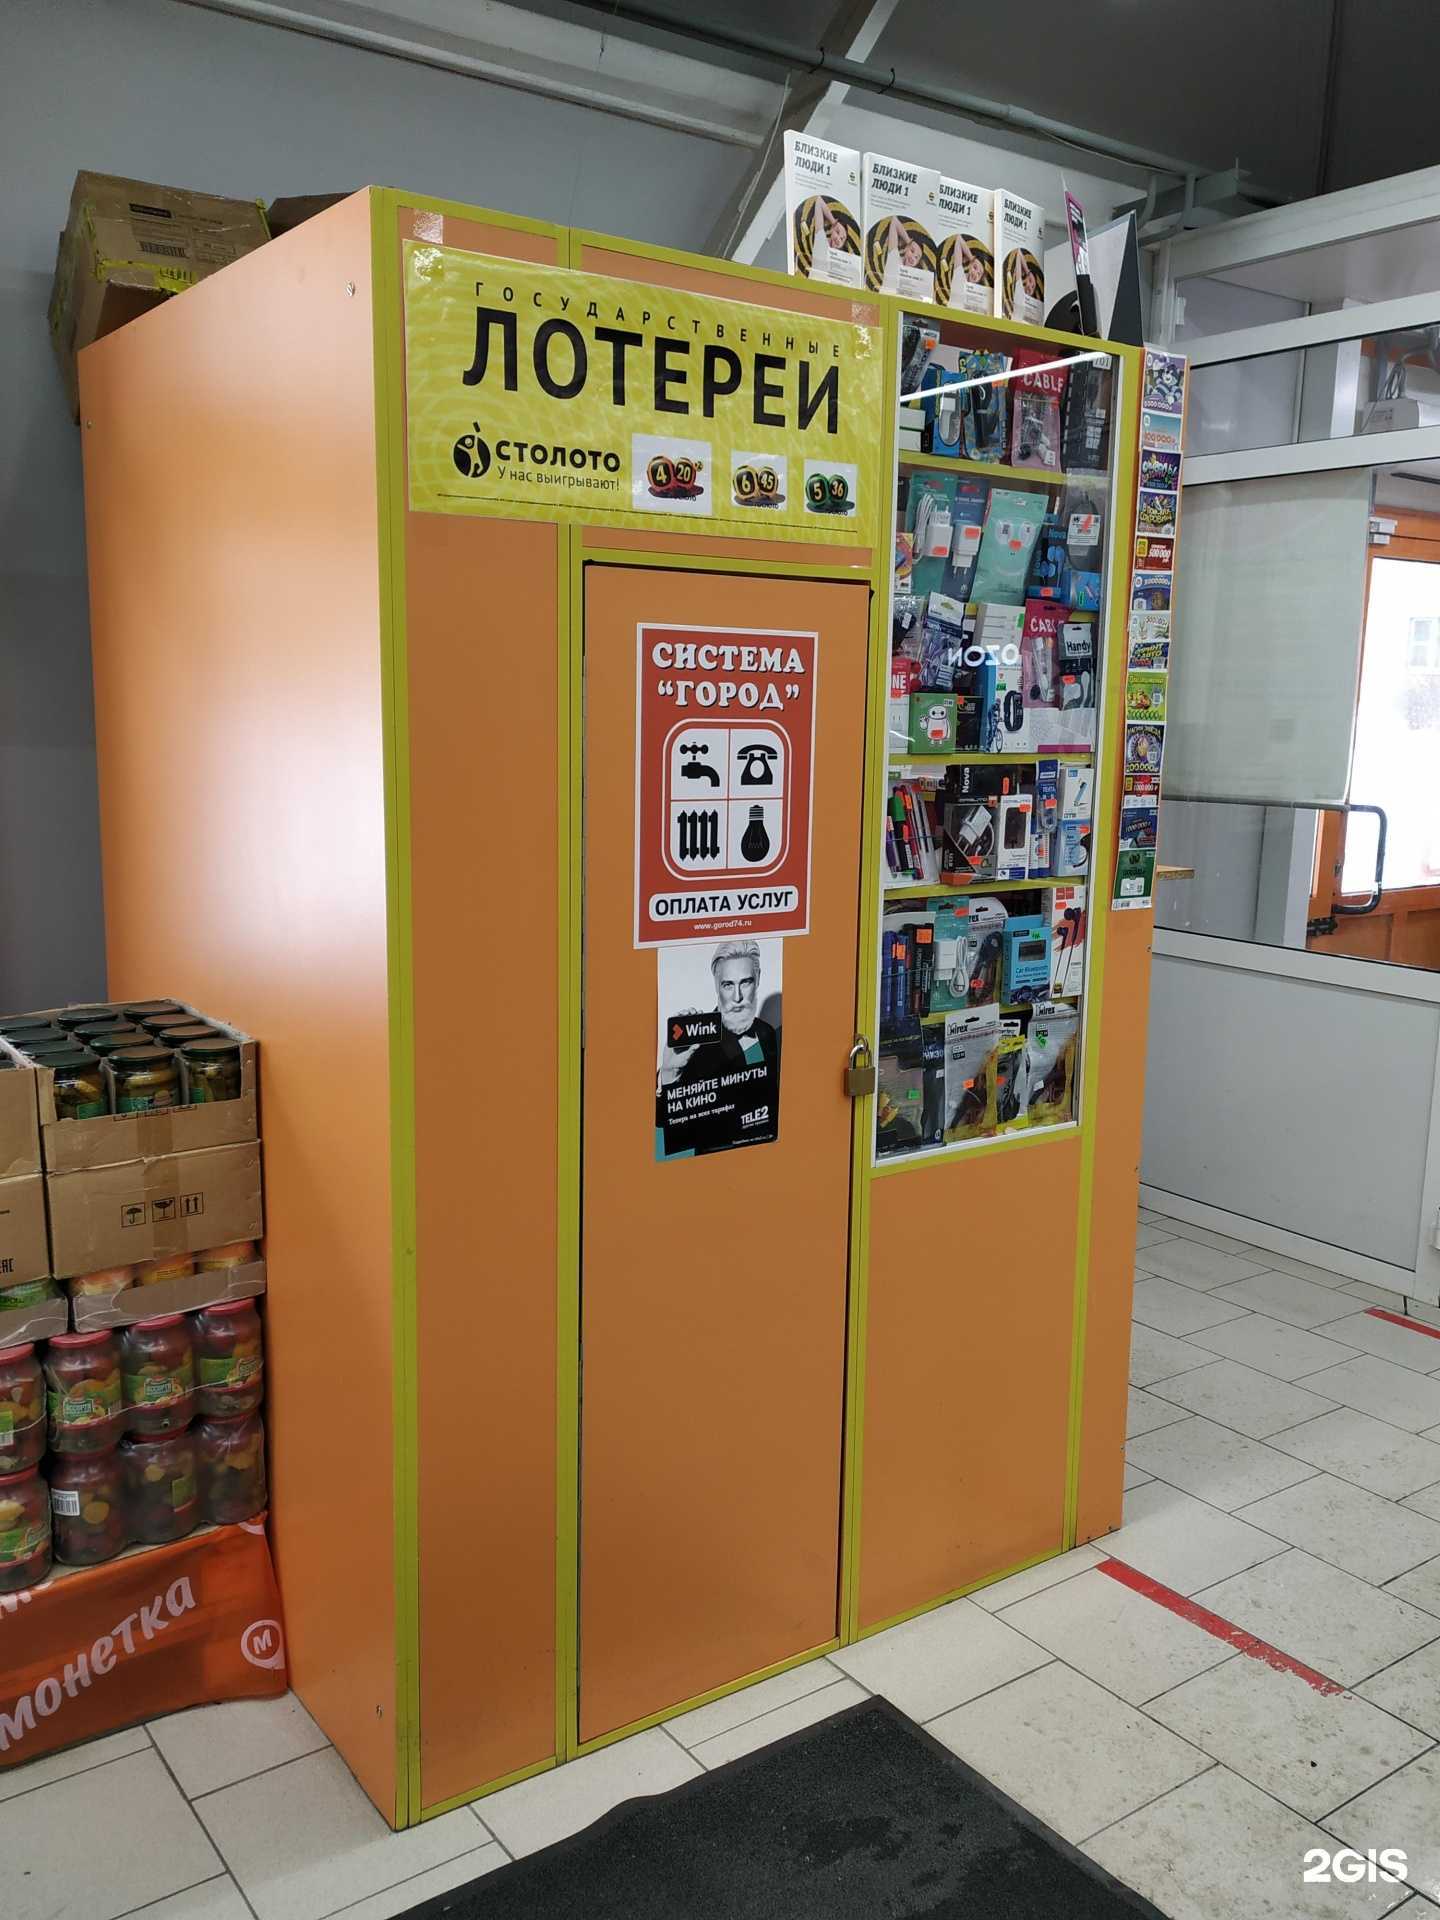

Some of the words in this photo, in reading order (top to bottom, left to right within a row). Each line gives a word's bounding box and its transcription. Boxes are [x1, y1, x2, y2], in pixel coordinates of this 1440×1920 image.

[794, 140, 838, 163] БЛИЗКИЕ
[795, 156, 825, 174] ЛЮДИ
[826, 165, 831, 176] 1
[872, 163, 918, 184] БЛИЗКИЕ
[872, 178, 903, 195] ЛЮДИ
[904, 187, 909, 197] 1
[939, 184, 979, 203] БЛИЗКИЕ
[938, 198, 965, 214] ЛЮДИ
[966, 206, 971, 216] 1
[1004, 198, 1032, 220] БЛИЗКИЕ
[1004, 212, 1024, 229] ЛЮДИ
[474, 280, 842, 358] ГОСУДАРСТВЕННЫЕ
[461, 305, 841, 435] ЛОТЕРЕИ
[1023, 372, 1064, 393] CABLE
[497, 465, 506, 480] У
[509, 469, 532, 483] нас
[536, 472, 620, 492] выигрывают!
[655, 466, 667, 484] 4
[676, 463, 691, 482] 20
[741, 474, 751, 493] 6
[760, 473, 774, 490] 45
[813, 484, 822, 500] 5
[831, 480, 844, 498] 36
[1066, 639, 1091, 653] Handy
[651, 641, 806, 674] СИСТЕМА
[657, 679, 801, 712] “ГОРОД”
[961, 767, 970, 793] Nova
[655, 895, 731, 916] ОПЛАТА
[737, 891, 793, 910] УСЛУГ
[693, 919, 752, 931] www.gorod74.ru
[685, 1021, 717, 1037] Wink
[667, 1078, 718, 1101] МЕНЯЙТЕ
[720, 1066, 768, 1088] МИНУТЫ
[667, 1101, 683, 1114] НА
[685, 1092, 717, 1109] КИНО
[741, 1105, 769, 1125] TELE2
